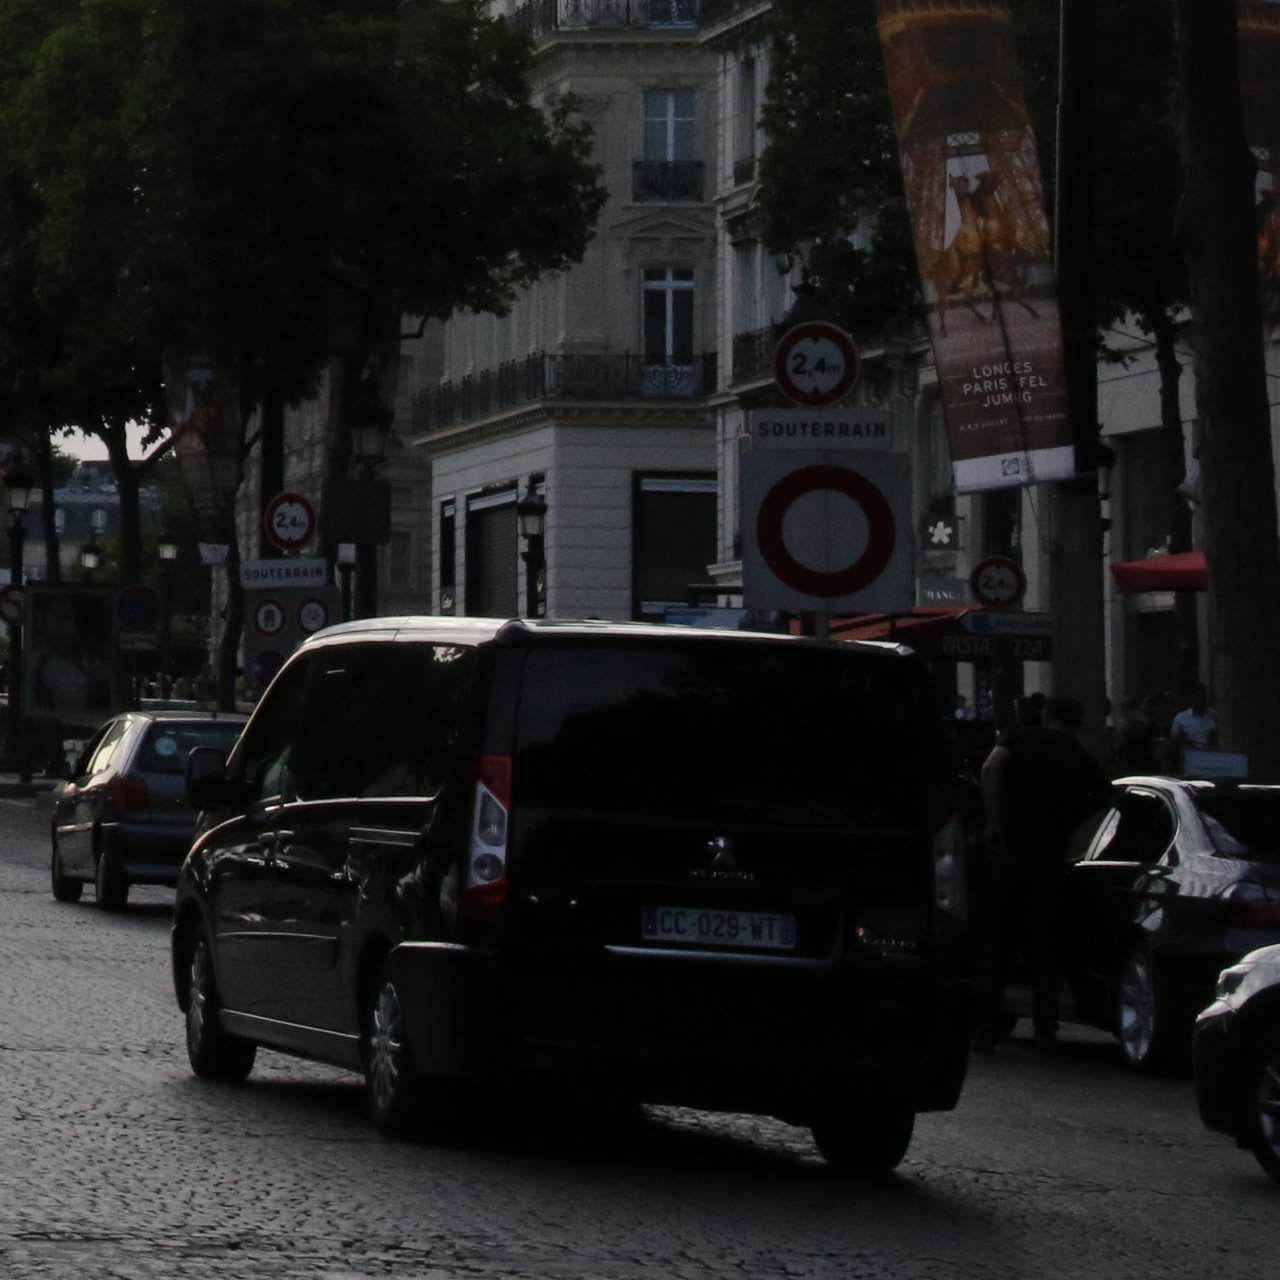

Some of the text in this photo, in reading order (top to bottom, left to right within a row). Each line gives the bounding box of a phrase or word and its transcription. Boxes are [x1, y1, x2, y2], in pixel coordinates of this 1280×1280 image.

[962, 378, 1008, 396] PARIS
[759, 422, 886, 438] SOUTERRAIN
[243, 568, 323, 581] SOUTERRAIN
[659, 910, 777, 941] CC-029-WT
